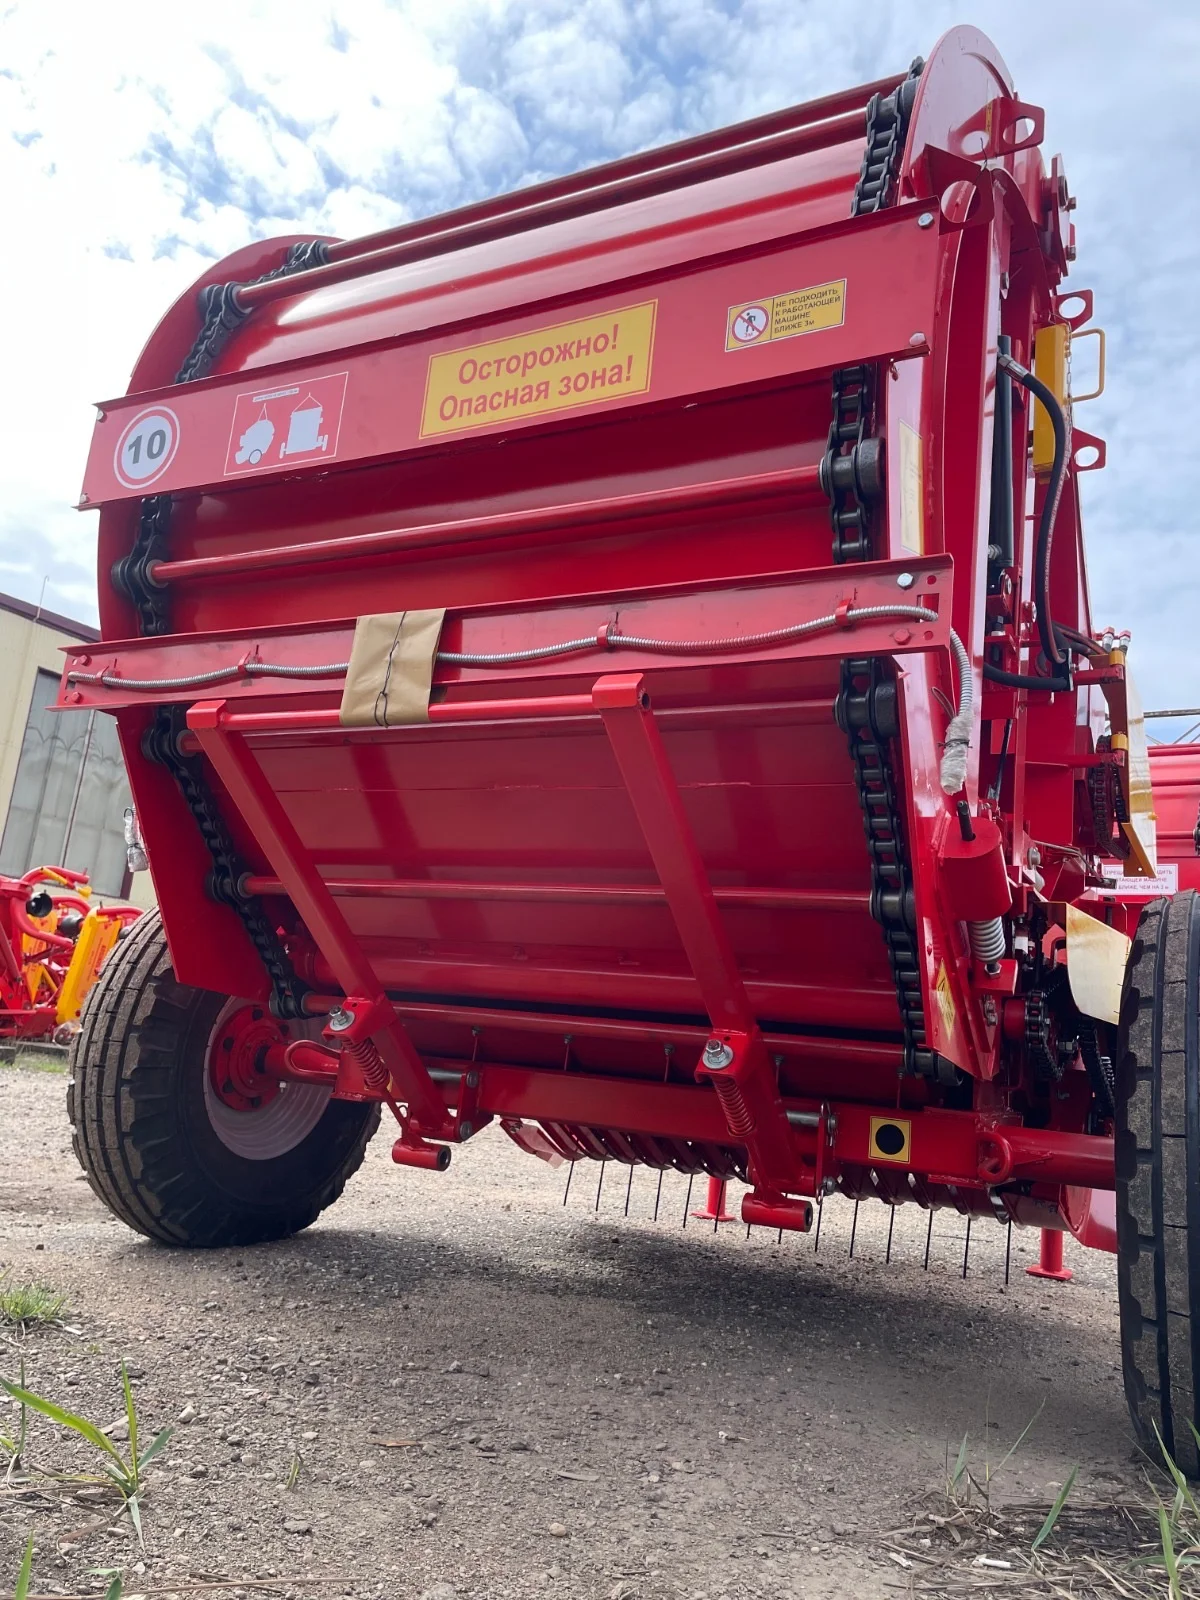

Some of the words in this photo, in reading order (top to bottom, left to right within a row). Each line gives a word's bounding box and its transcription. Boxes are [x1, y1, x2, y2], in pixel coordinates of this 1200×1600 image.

[775, 300, 787, 308] НЕ
[788, 288, 838, 306] ПОДХОДИТЬ
[782, 295, 841, 315] РАБОТАЮЩЕЙ
[774, 311, 811, 325] МАШИНЕ
[774, 323, 802, 334] БЛИЖЕ
[458, 323, 619, 385] Осторожно!
[439, 380, 550, 421] Опасная
[557, 355, 634, 396] зона!
[127, 429, 167, 465] 10
